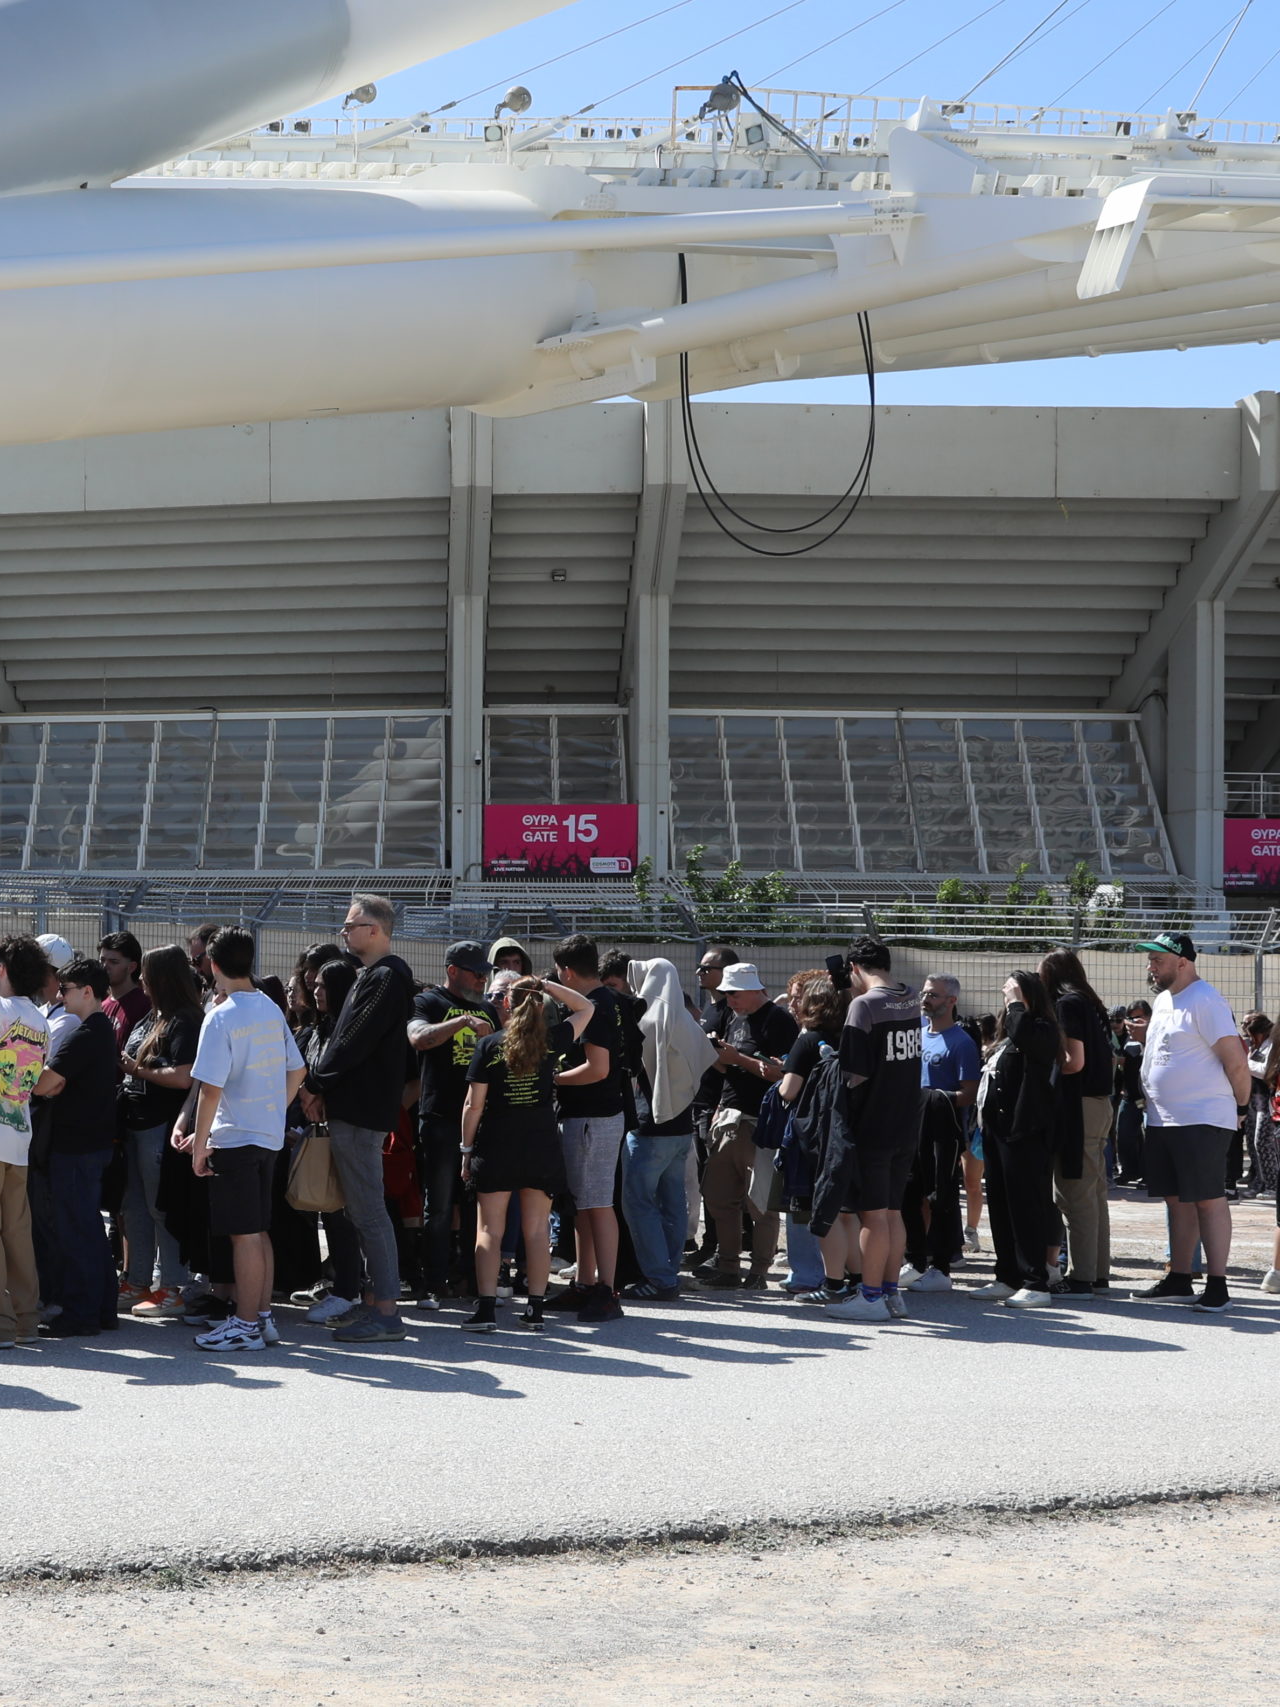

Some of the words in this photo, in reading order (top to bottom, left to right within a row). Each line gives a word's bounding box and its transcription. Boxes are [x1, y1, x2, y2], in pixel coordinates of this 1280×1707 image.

[522, 814, 558, 826] ΘΥΡΑ
[562, 814, 599, 843] 15
[522, 831, 558, 843] GATE
